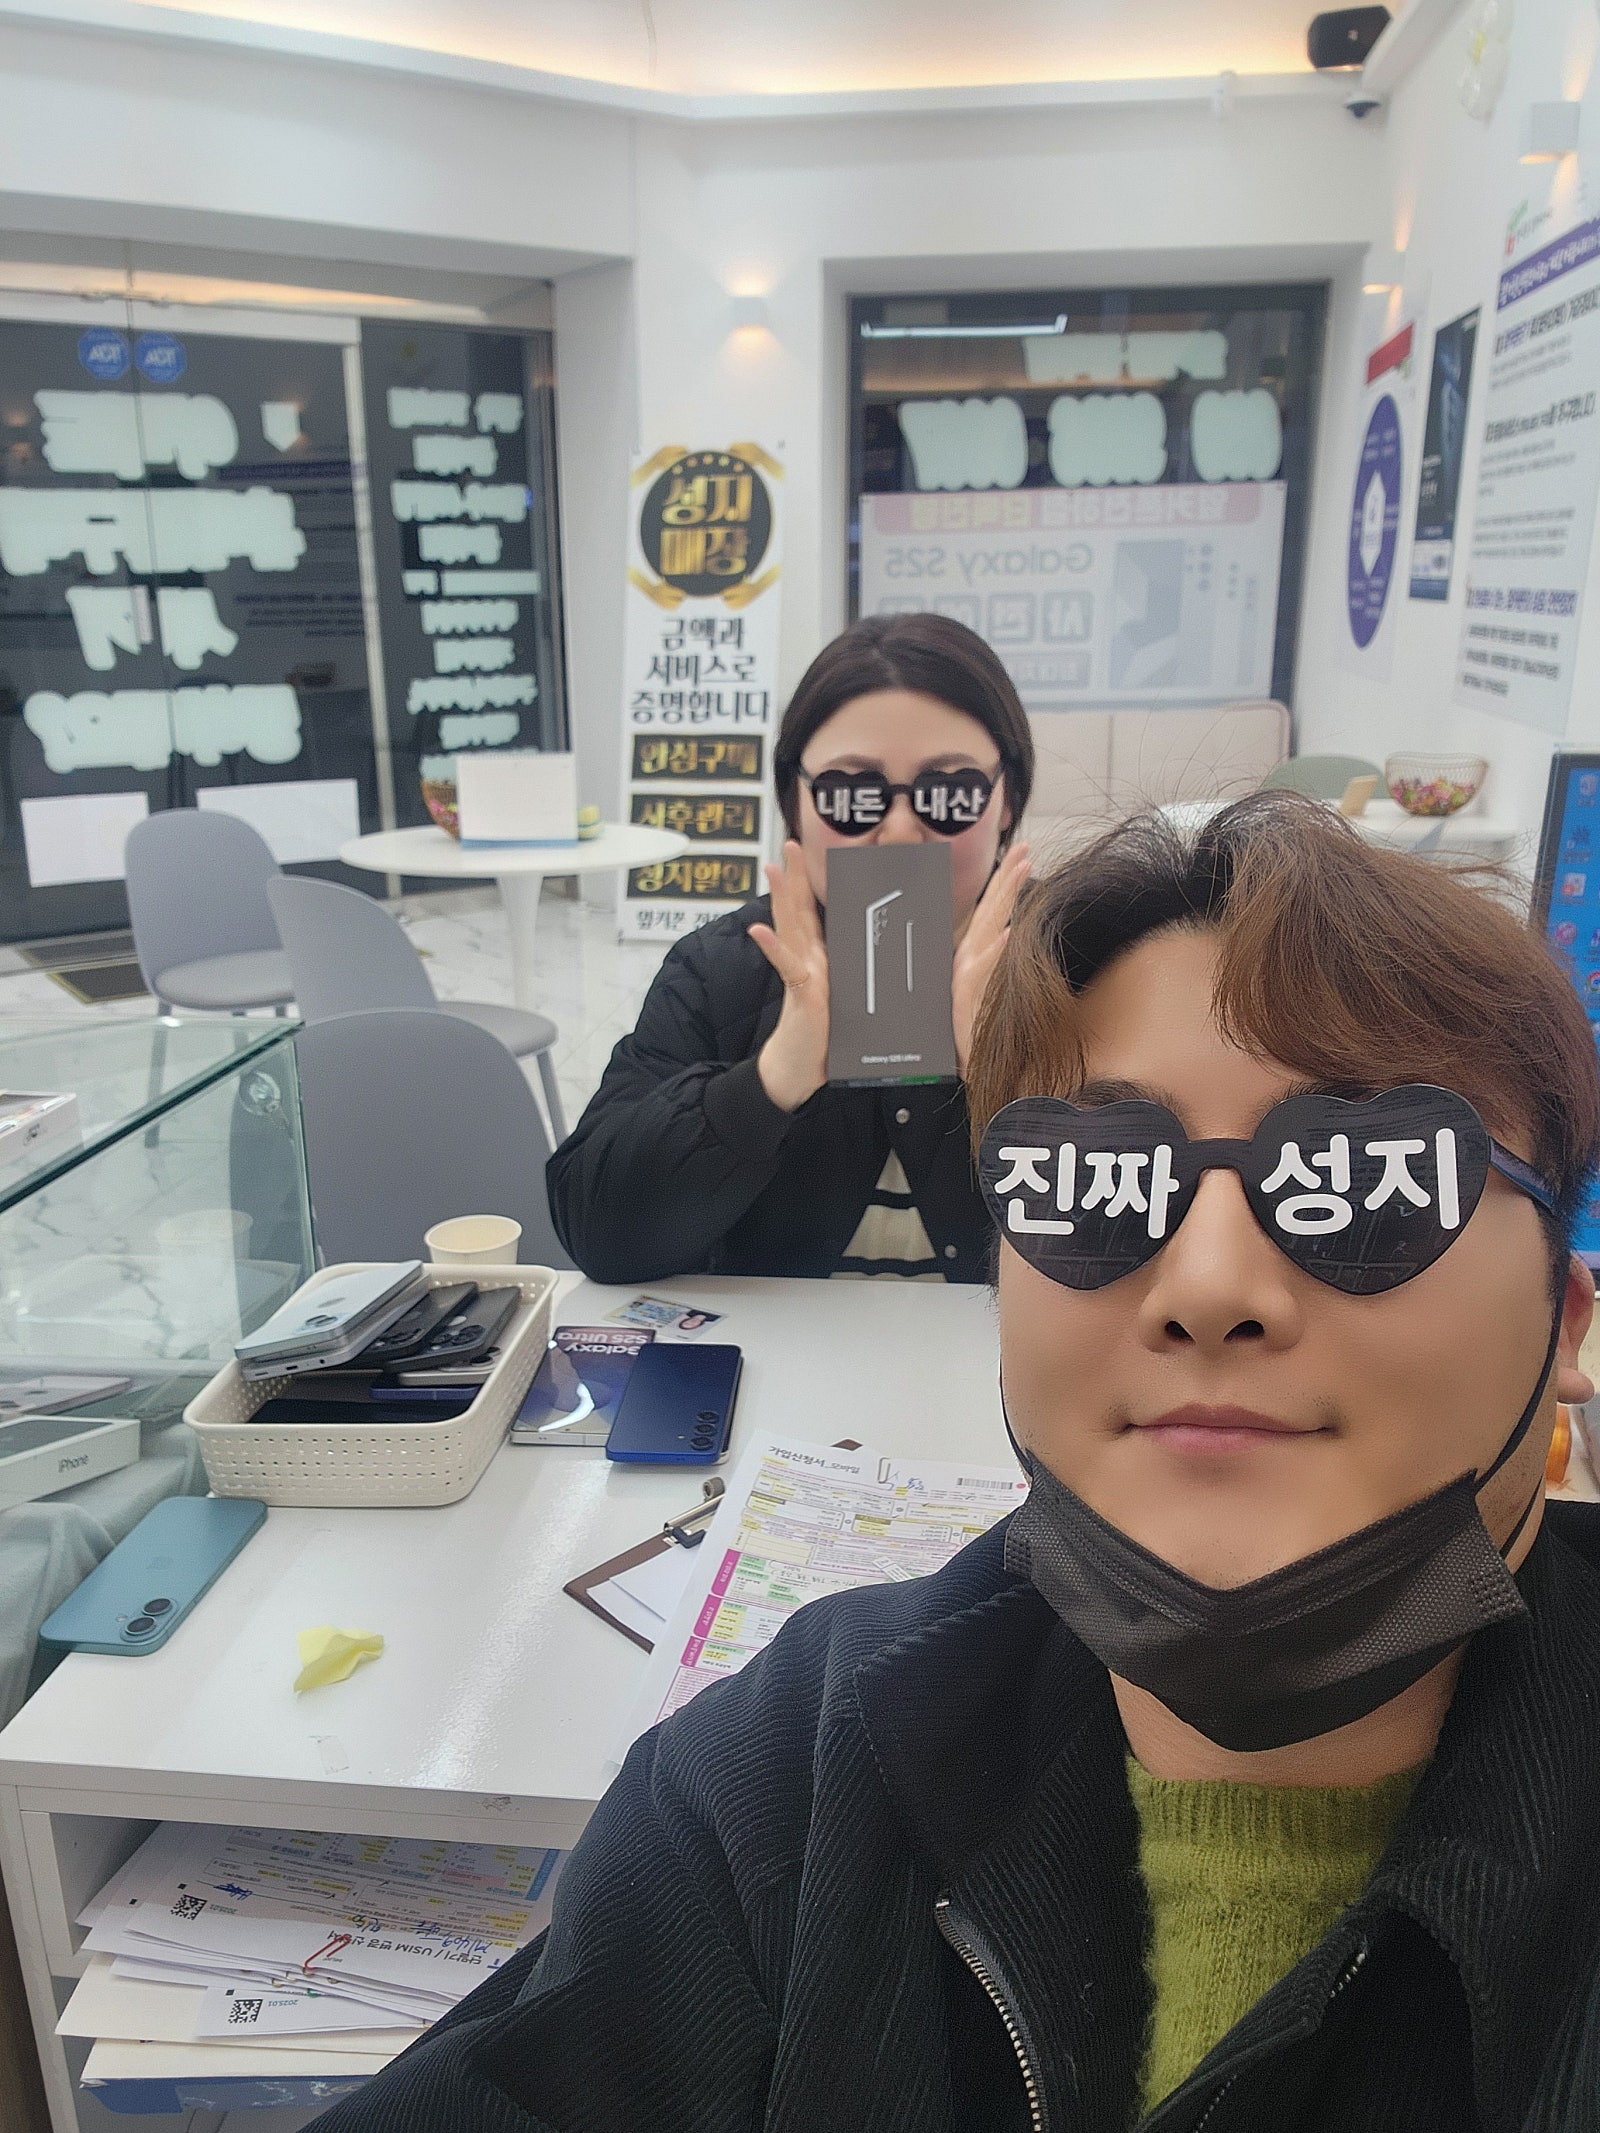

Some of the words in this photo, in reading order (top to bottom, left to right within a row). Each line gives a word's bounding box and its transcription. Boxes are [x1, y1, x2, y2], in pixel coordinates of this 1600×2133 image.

[661, 474, 752, 525] 성지
[660, 527, 749, 576] 매장
[661, 617, 744, 650] 금액과
[647, 655, 756, 686] 서비스로
[631, 690, 770, 725] 증명합니다
[640, 740, 758, 775] 안심구매
[817, 787, 886, 823] 내돈
[913, 785, 985, 822] 내산
[994, 1142, 1179, 1239] 진짜
[1260, 1128, 1460, 1236] 성지
[557, 1331, 609, 1344] Ultra
[612, 1333, 648, 1344] S25
[367, 1938, 393, 1951] 변경
[395, 1943, 434, 1956] USIM
[444, 1948, 483, 1965] 단말기
